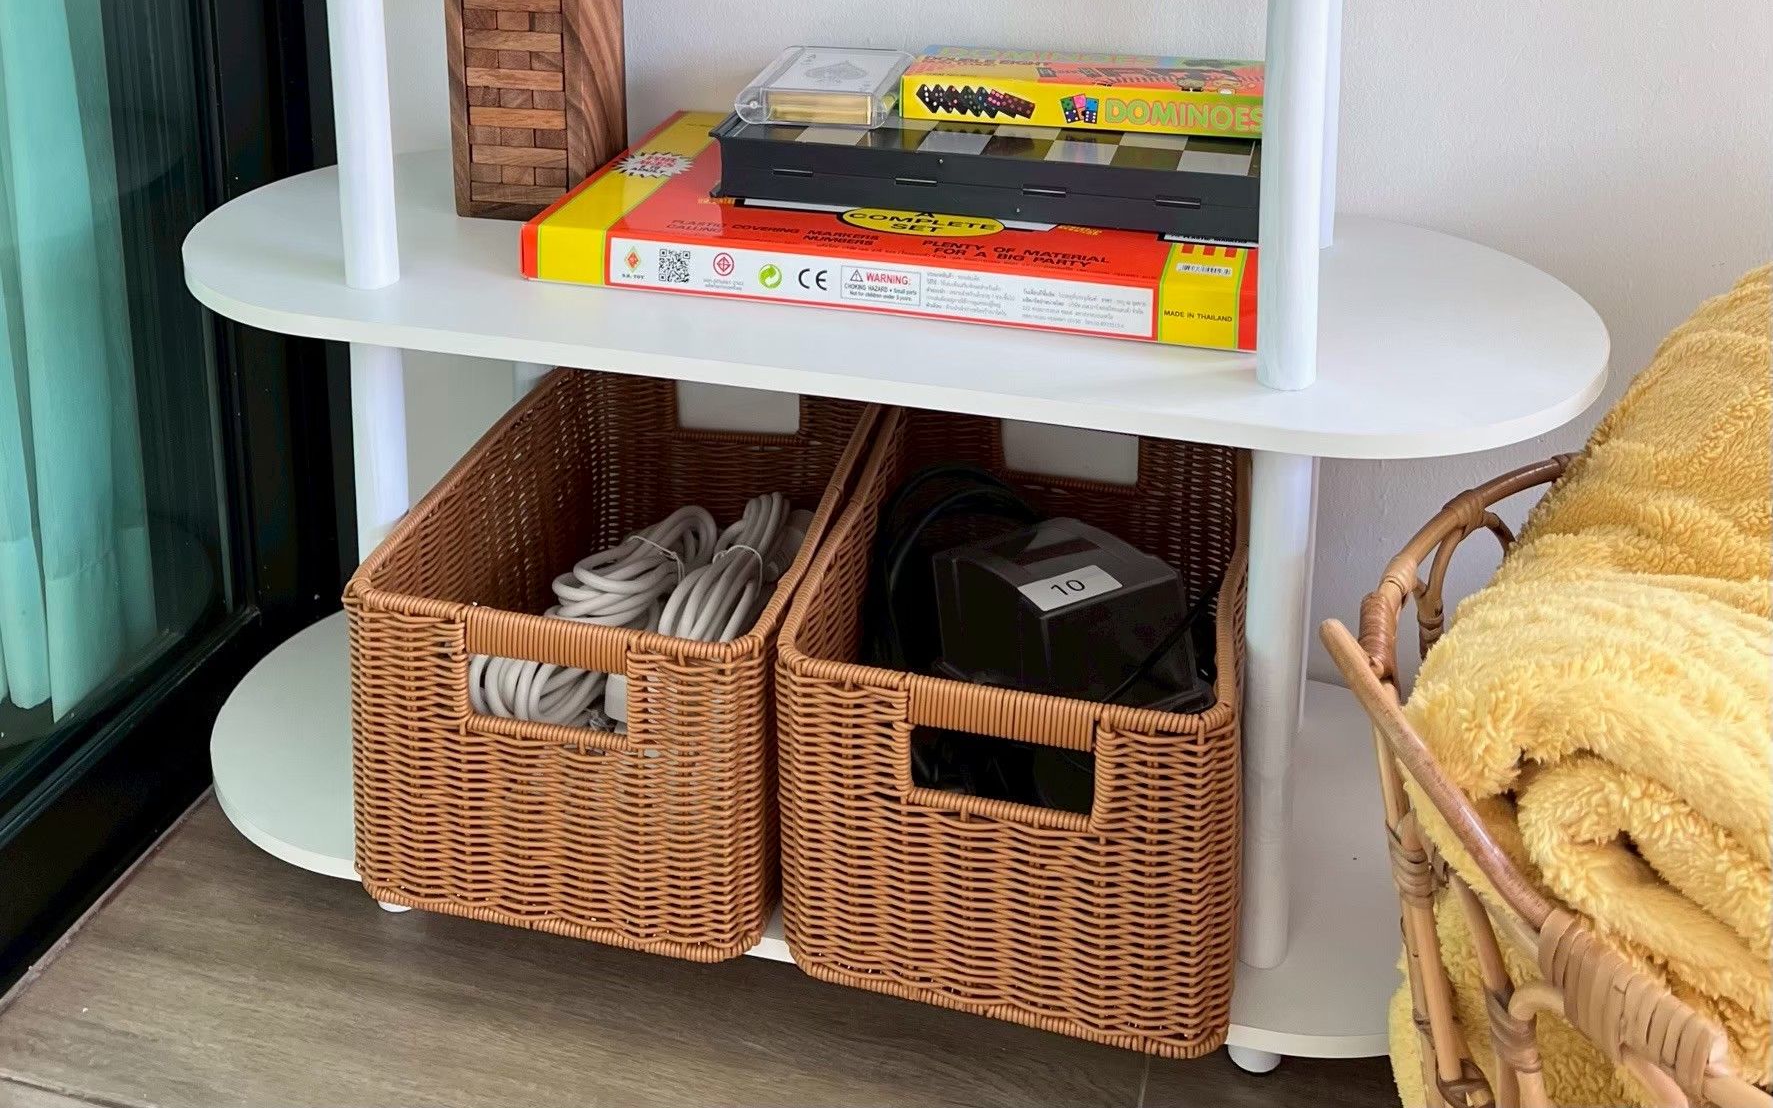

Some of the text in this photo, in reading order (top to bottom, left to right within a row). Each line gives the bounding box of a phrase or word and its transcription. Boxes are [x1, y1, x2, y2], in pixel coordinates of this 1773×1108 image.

[1104, 97, 1264, 132] DOMINOES
[849, 212, 997, 231] COMPLETE
[890, 223, 942, 233] SET
[731, 223, 801, 234] COVERING
[807, 229, 880, 241] MARKERS
[802, 235, 875, 246] NUMBERS
[922, 240, 985, 251] PLENTY
[993, 246, 1017, 254] OF
[1023, 249, 1111, 264] MATERIAL
[933, 247, 967, 256] FOR
[974, 250, 988, 259] A
[996, 253, 1025, 262] BIG
[1033, 256, 1092, 268] PARTY
[798, 268, 828, 291] CE
[844, 282, 867, 291] CHOKING
[868, 285, 888, 293] HAZARD
[866, 272, 911, 286] WARNING:
[1163, 310, 1185, 318] MADE
[1197, 313, 1233, 323] THAILAND
[1050, 579, 1085, 596] 10
